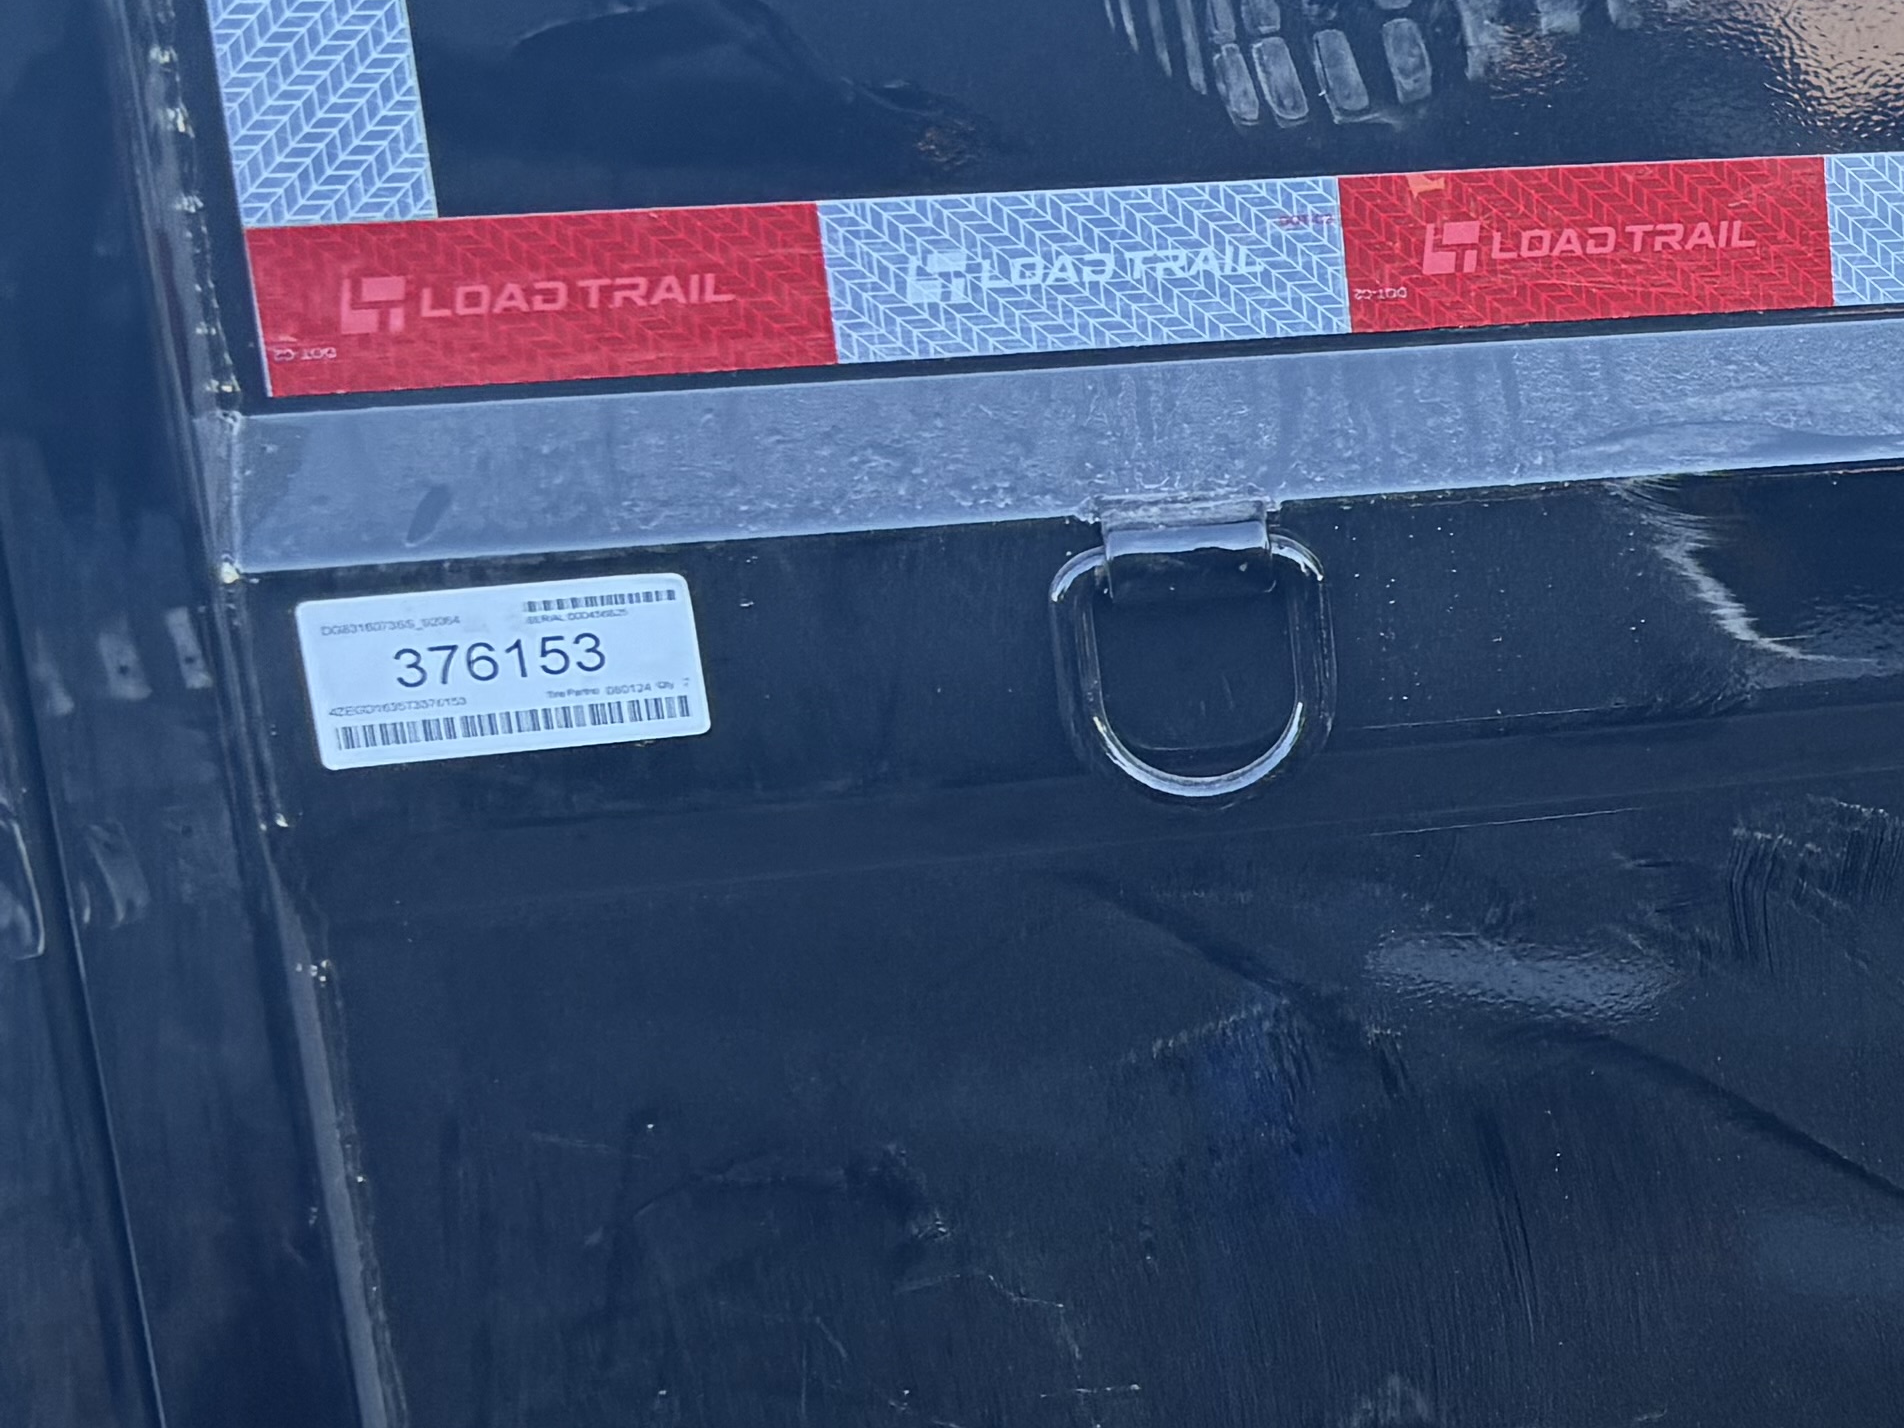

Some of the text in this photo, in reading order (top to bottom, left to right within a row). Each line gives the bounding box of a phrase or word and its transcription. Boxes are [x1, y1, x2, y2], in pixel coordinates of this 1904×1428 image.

[1490, 219, 1758, 260] LOAD TRAIL
[979, 245, 1267, 290] LOAD TRAIL
[420, 272, 735, 318] LOAD TRAIL
[393, 632, 607, 689] 376153
